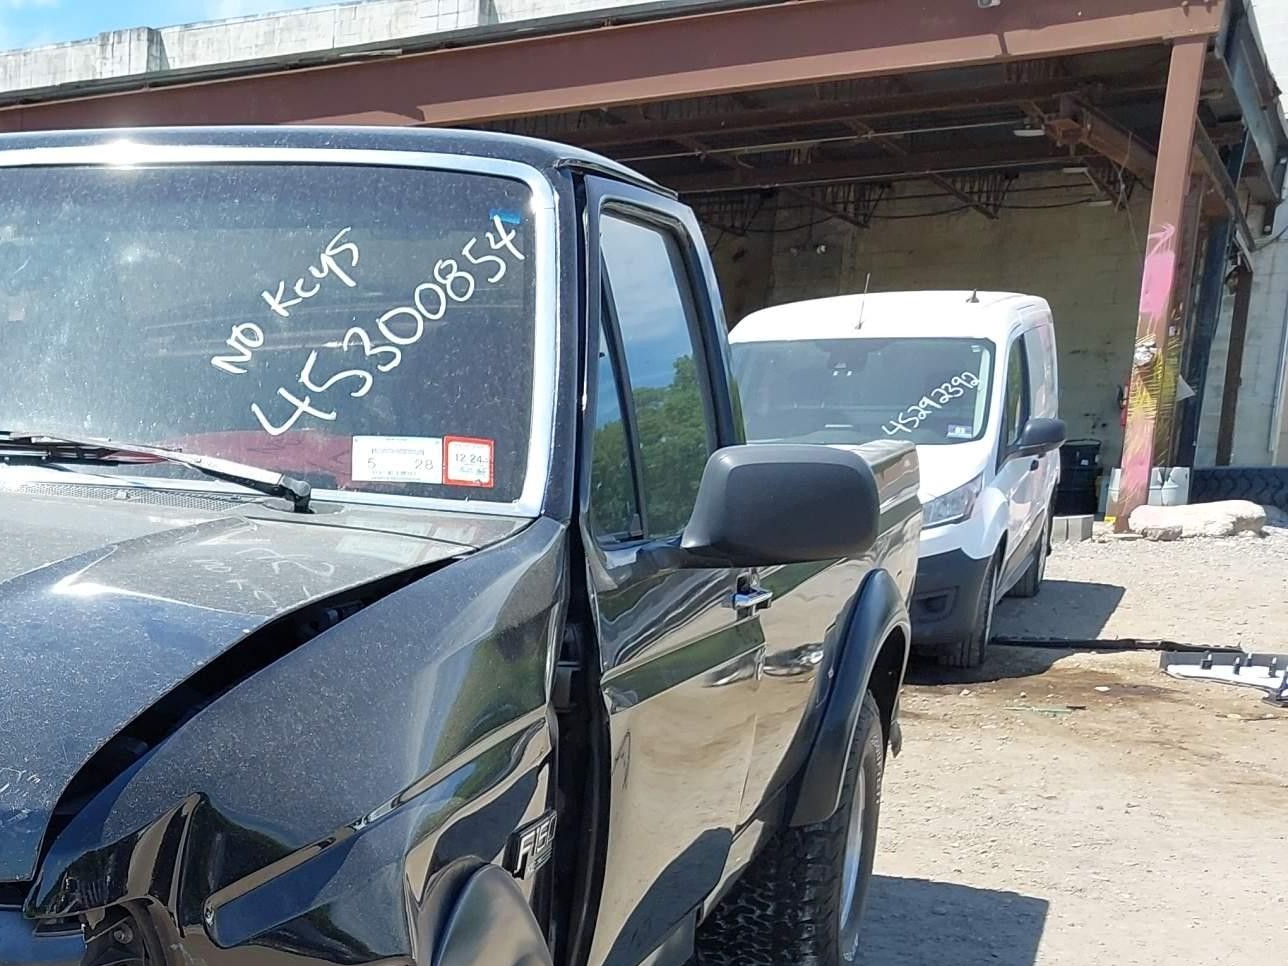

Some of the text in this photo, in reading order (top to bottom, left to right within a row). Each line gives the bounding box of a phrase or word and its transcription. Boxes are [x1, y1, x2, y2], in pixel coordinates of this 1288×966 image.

[211, 322, 265, 375] NO
[250, 214, 526, 436] 45300854
[881, 371, 980, 435] 45292392
